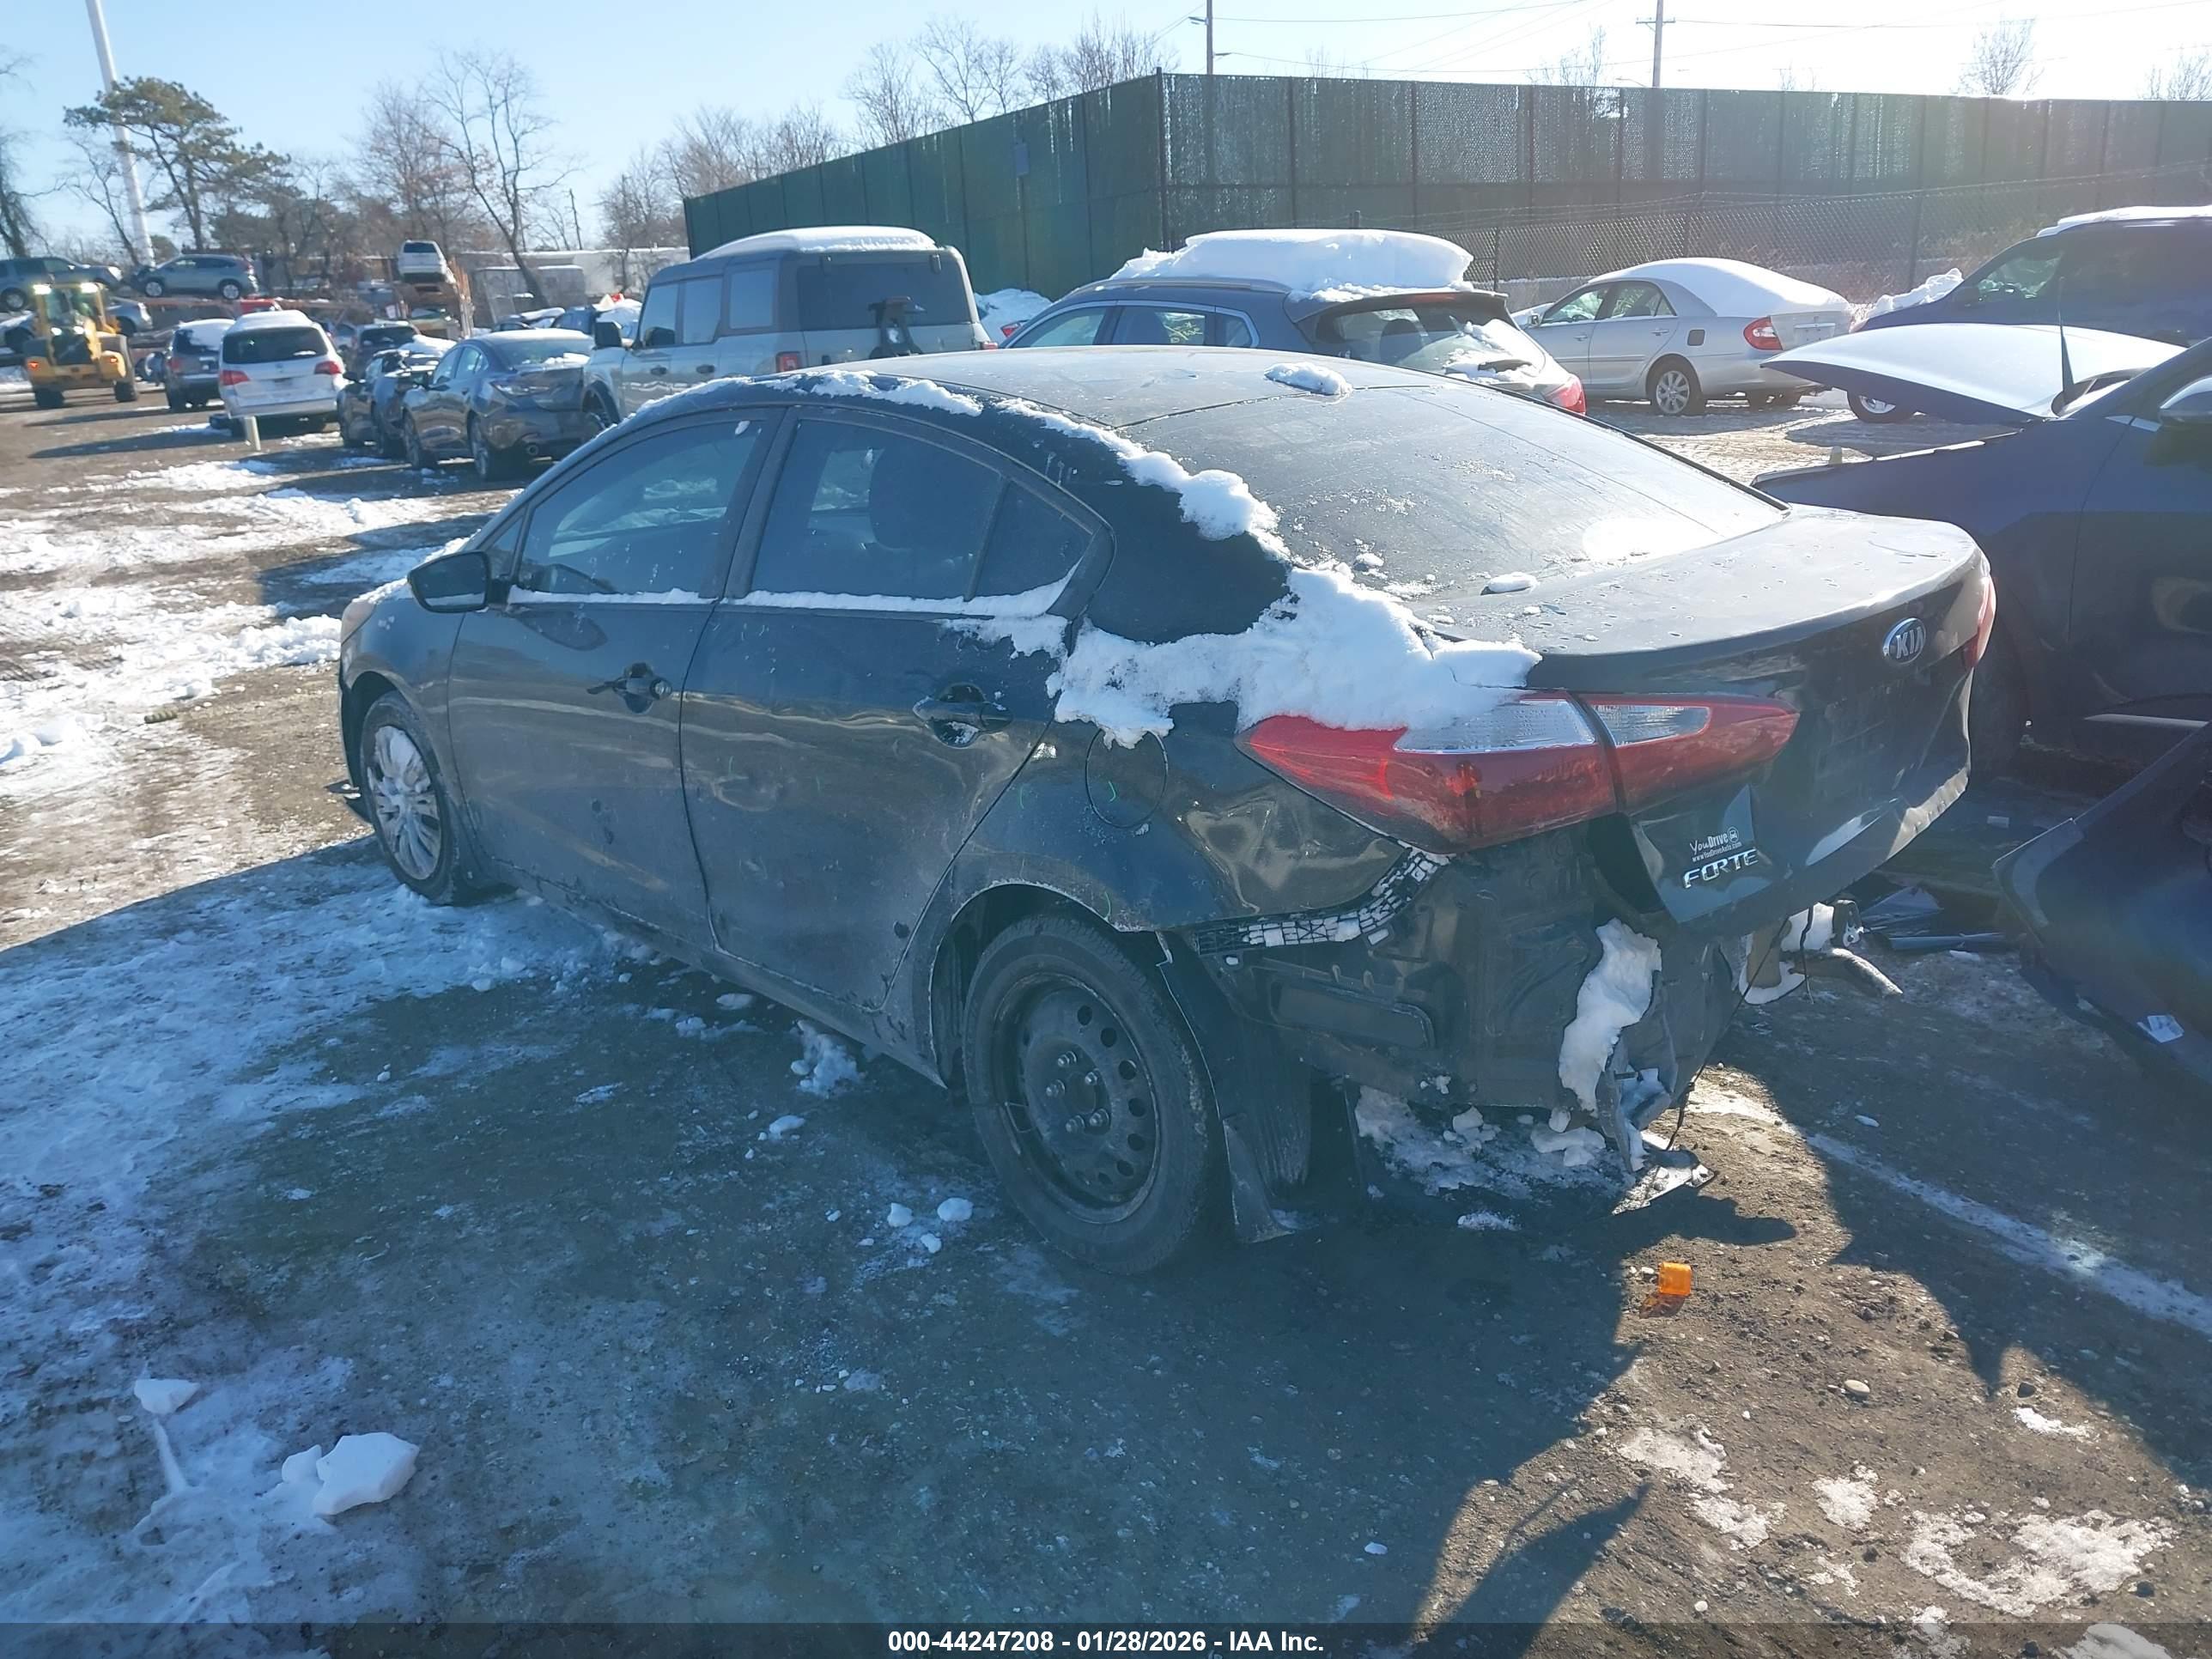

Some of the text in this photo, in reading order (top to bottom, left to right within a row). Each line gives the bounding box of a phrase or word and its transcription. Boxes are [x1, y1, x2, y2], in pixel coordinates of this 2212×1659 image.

[1895, 626, 1923, 659] KIA
[1689, 832, 1729, 855] YouDrive
[1682, 848, 1759, 890] FORTE
